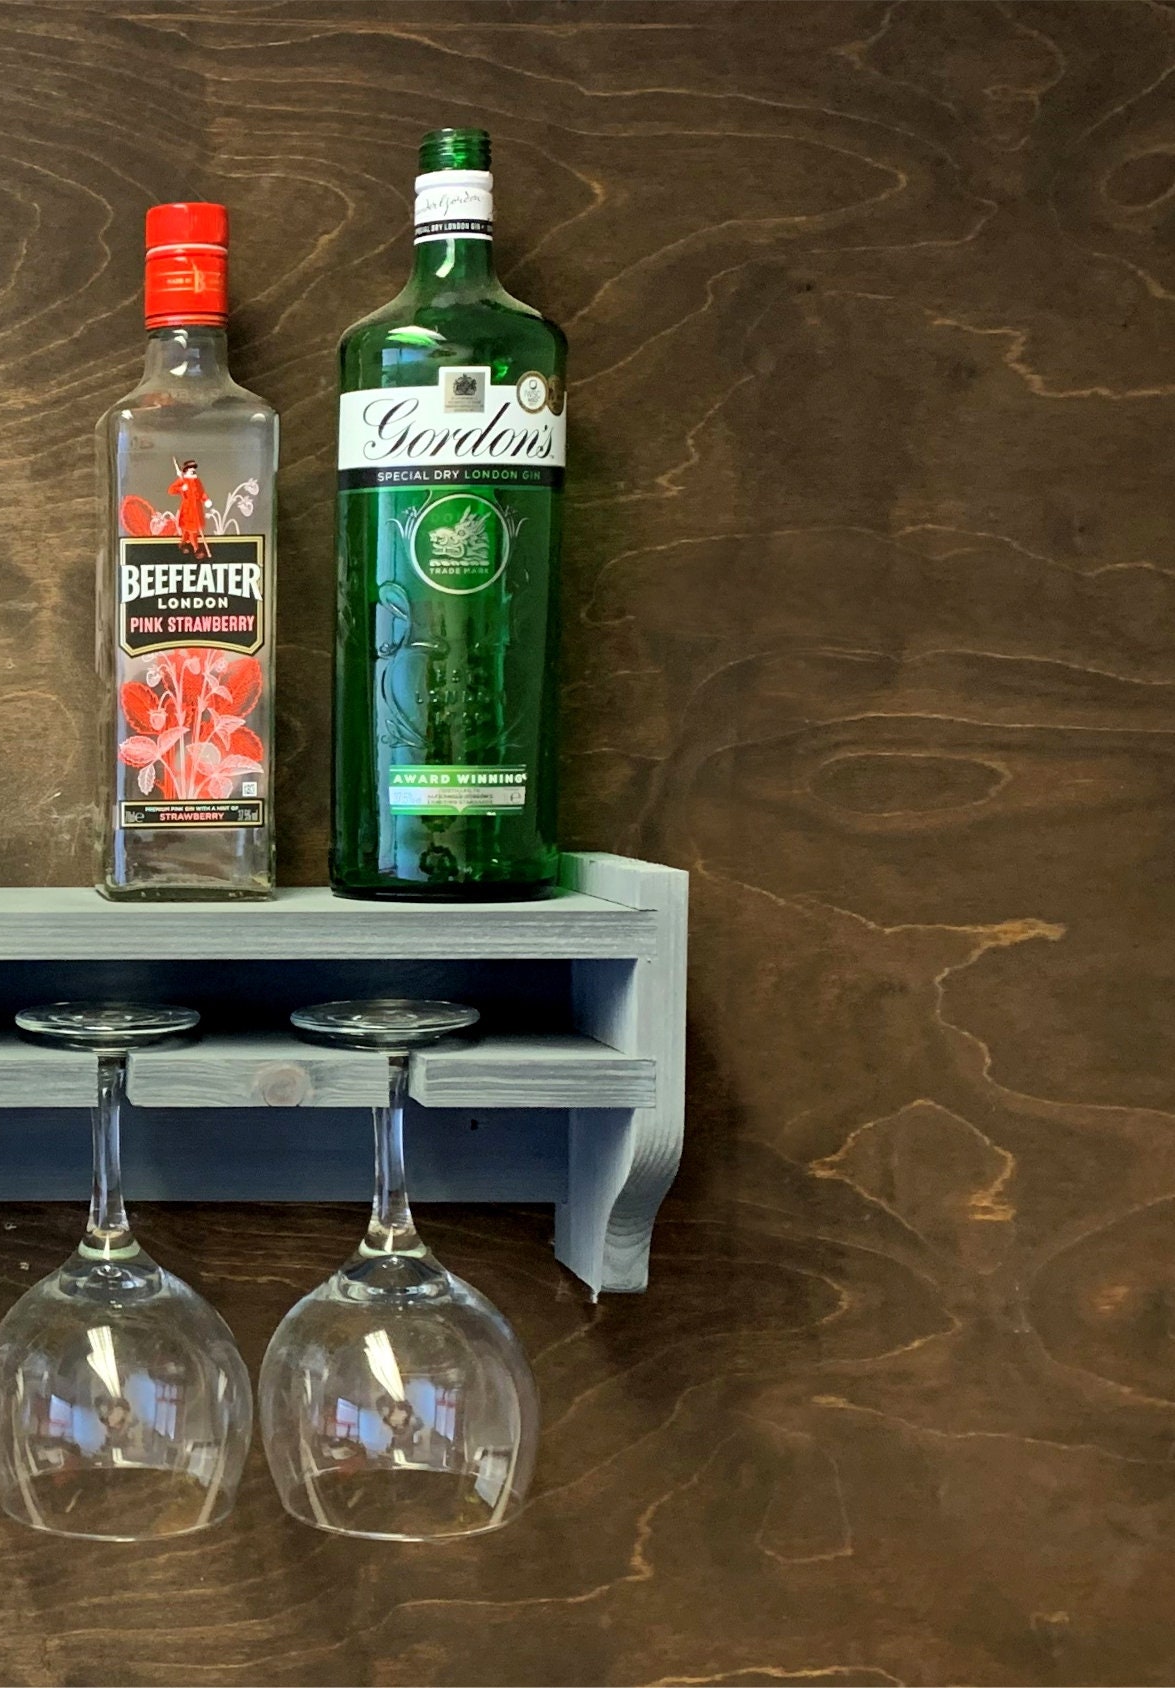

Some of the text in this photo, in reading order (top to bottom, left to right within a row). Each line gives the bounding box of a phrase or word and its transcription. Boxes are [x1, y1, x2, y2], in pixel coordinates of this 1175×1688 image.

[362, 397, 552, 460] Gordon's
[377, 469, 541, 482] SPECIAL DRY LONDON GIN
[429, 567, 489, 575] TRADE MARK
[120, 562, 264, 604] BEEFEATER
[157, 596, 229, 610] LONDON
[130, 615, 255, 633] PINK STRAWBERRY
[393, 773, 523, 784] AWARD WINNING
[159, 812, 225, 822] STRAWBERRY
